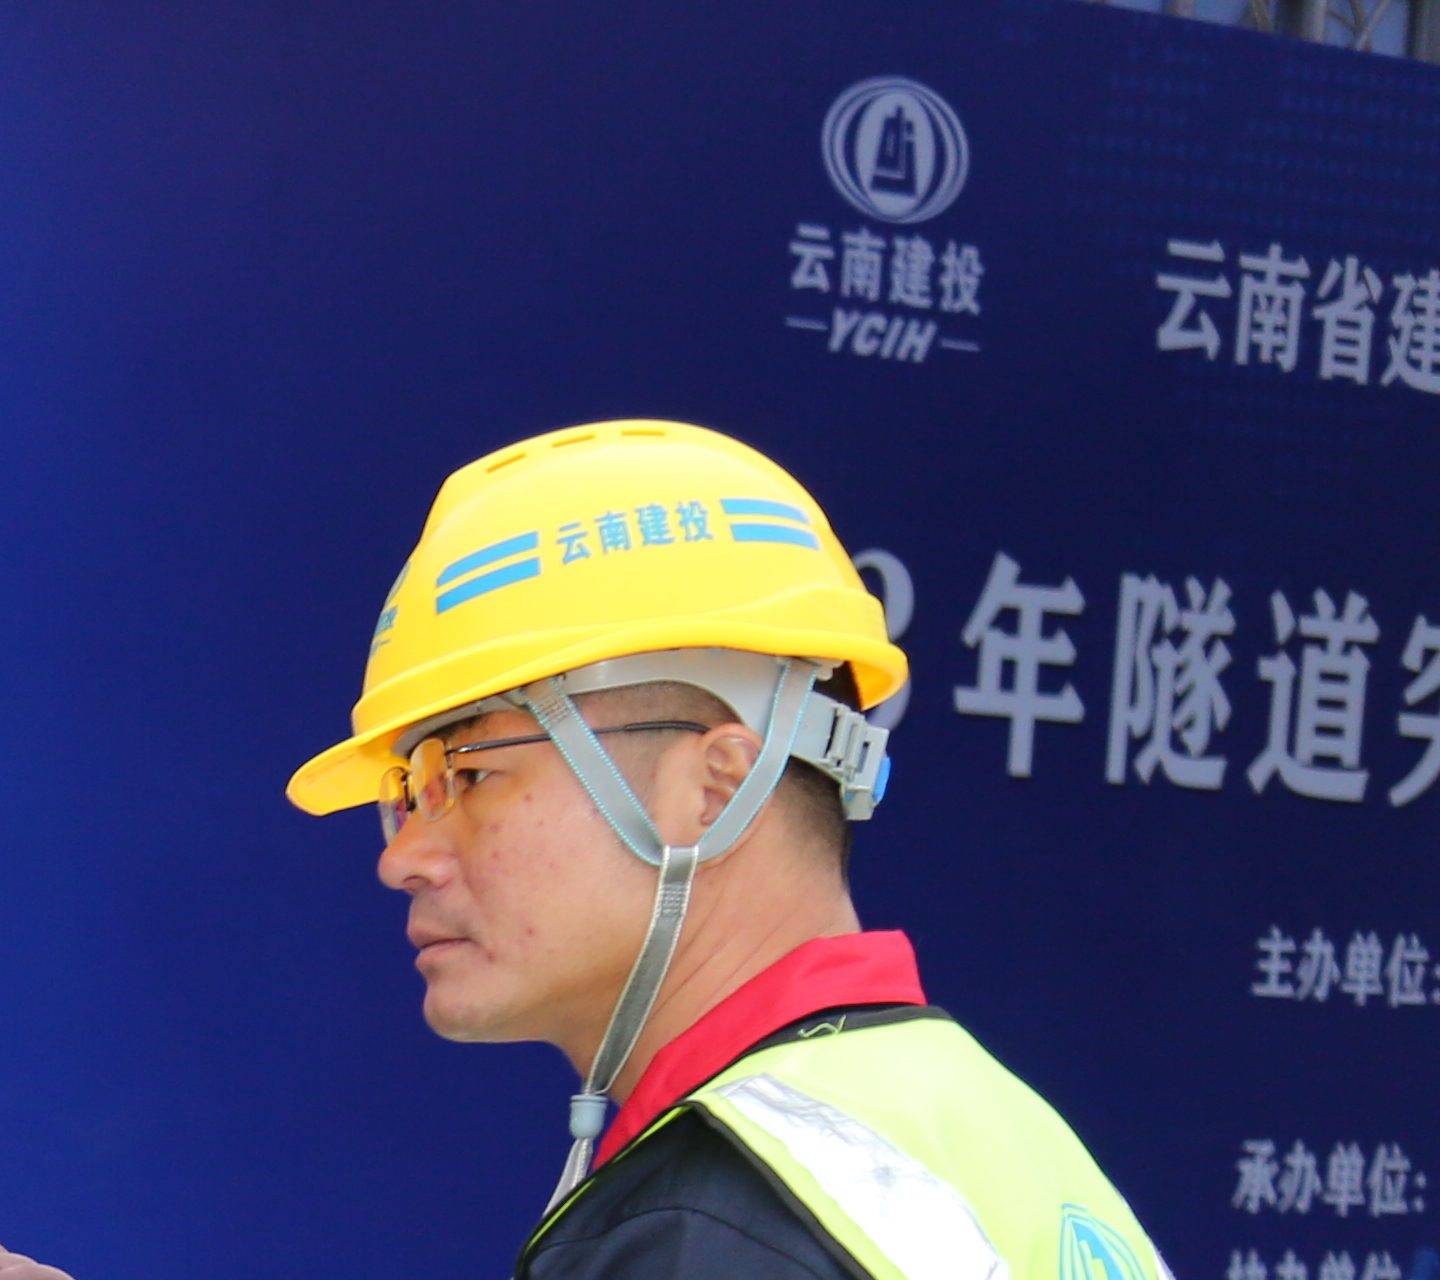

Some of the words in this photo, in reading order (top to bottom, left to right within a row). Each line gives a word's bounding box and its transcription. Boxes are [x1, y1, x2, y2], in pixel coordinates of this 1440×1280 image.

[789, 222, 984, 316] 云南建投
[556, 501, 715, 565] 云南建投
